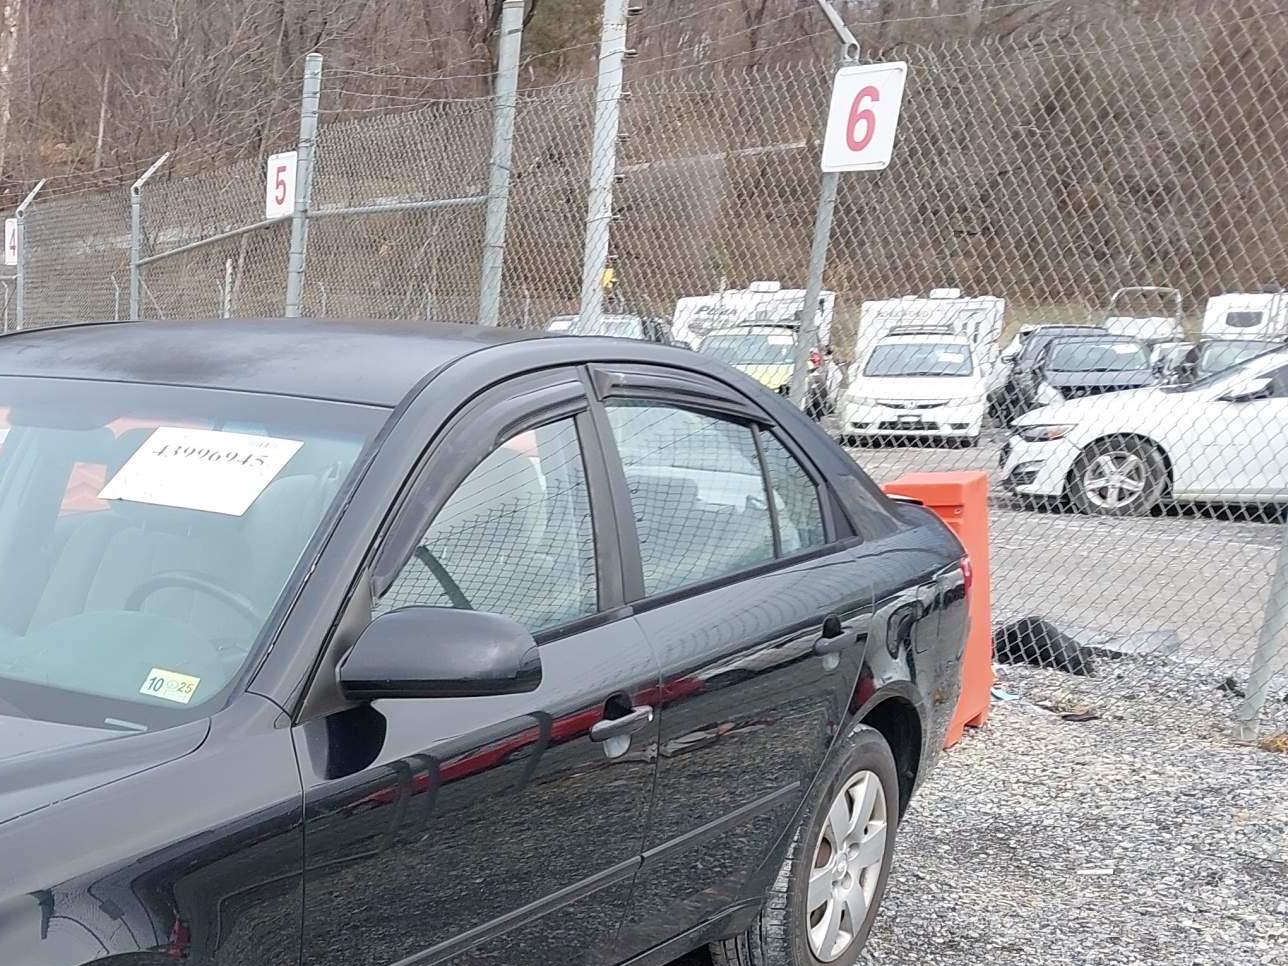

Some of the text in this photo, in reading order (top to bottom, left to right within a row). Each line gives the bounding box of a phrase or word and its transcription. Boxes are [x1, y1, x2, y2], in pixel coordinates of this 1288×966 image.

[846, 85, 880, 152] 6
[275, 165, 287, 206] 5
[9, 228, 16, 257] 4
[152, 444, 269, 466] 43996945
[148, 676, 194, 694] 10 25
